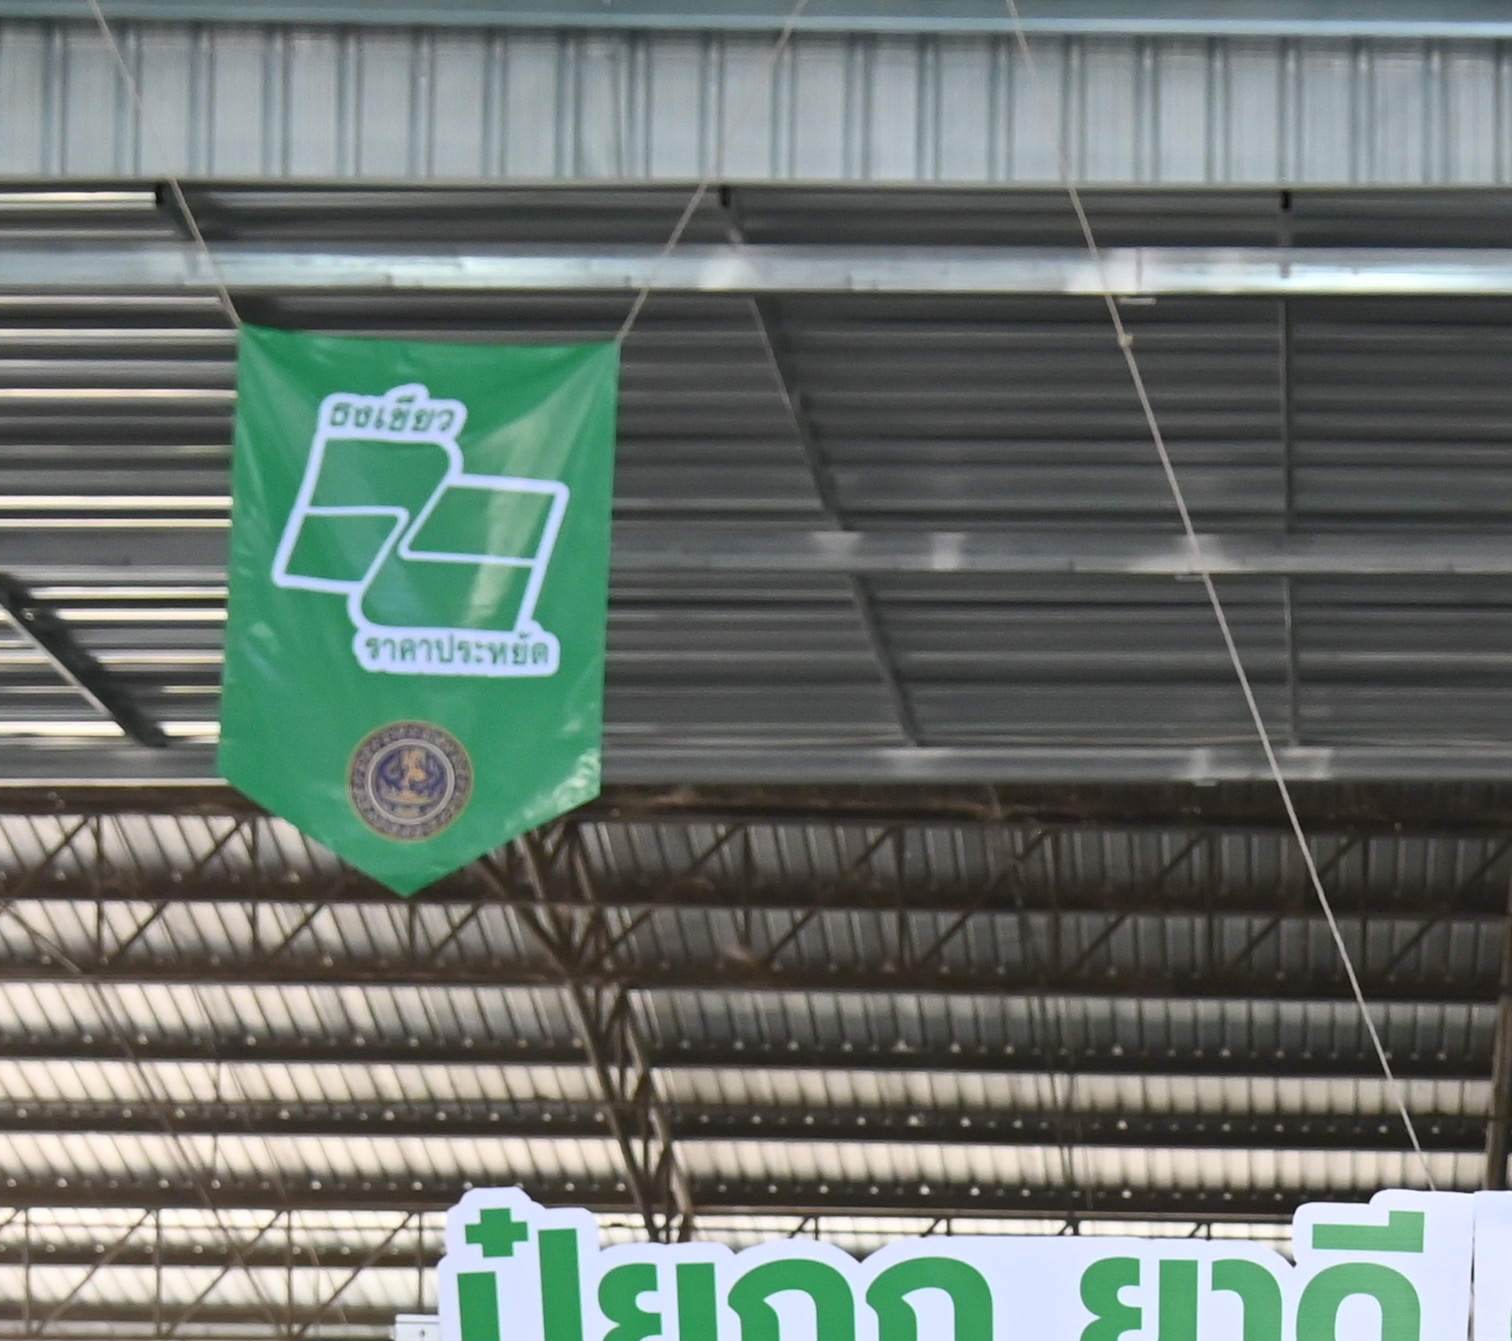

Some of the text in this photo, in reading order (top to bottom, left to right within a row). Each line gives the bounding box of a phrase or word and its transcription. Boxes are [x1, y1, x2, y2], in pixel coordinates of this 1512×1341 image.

[329, 394, 456, 434] ธงเขียว
[364, 628, 549, 667] ราคาประหยัด
